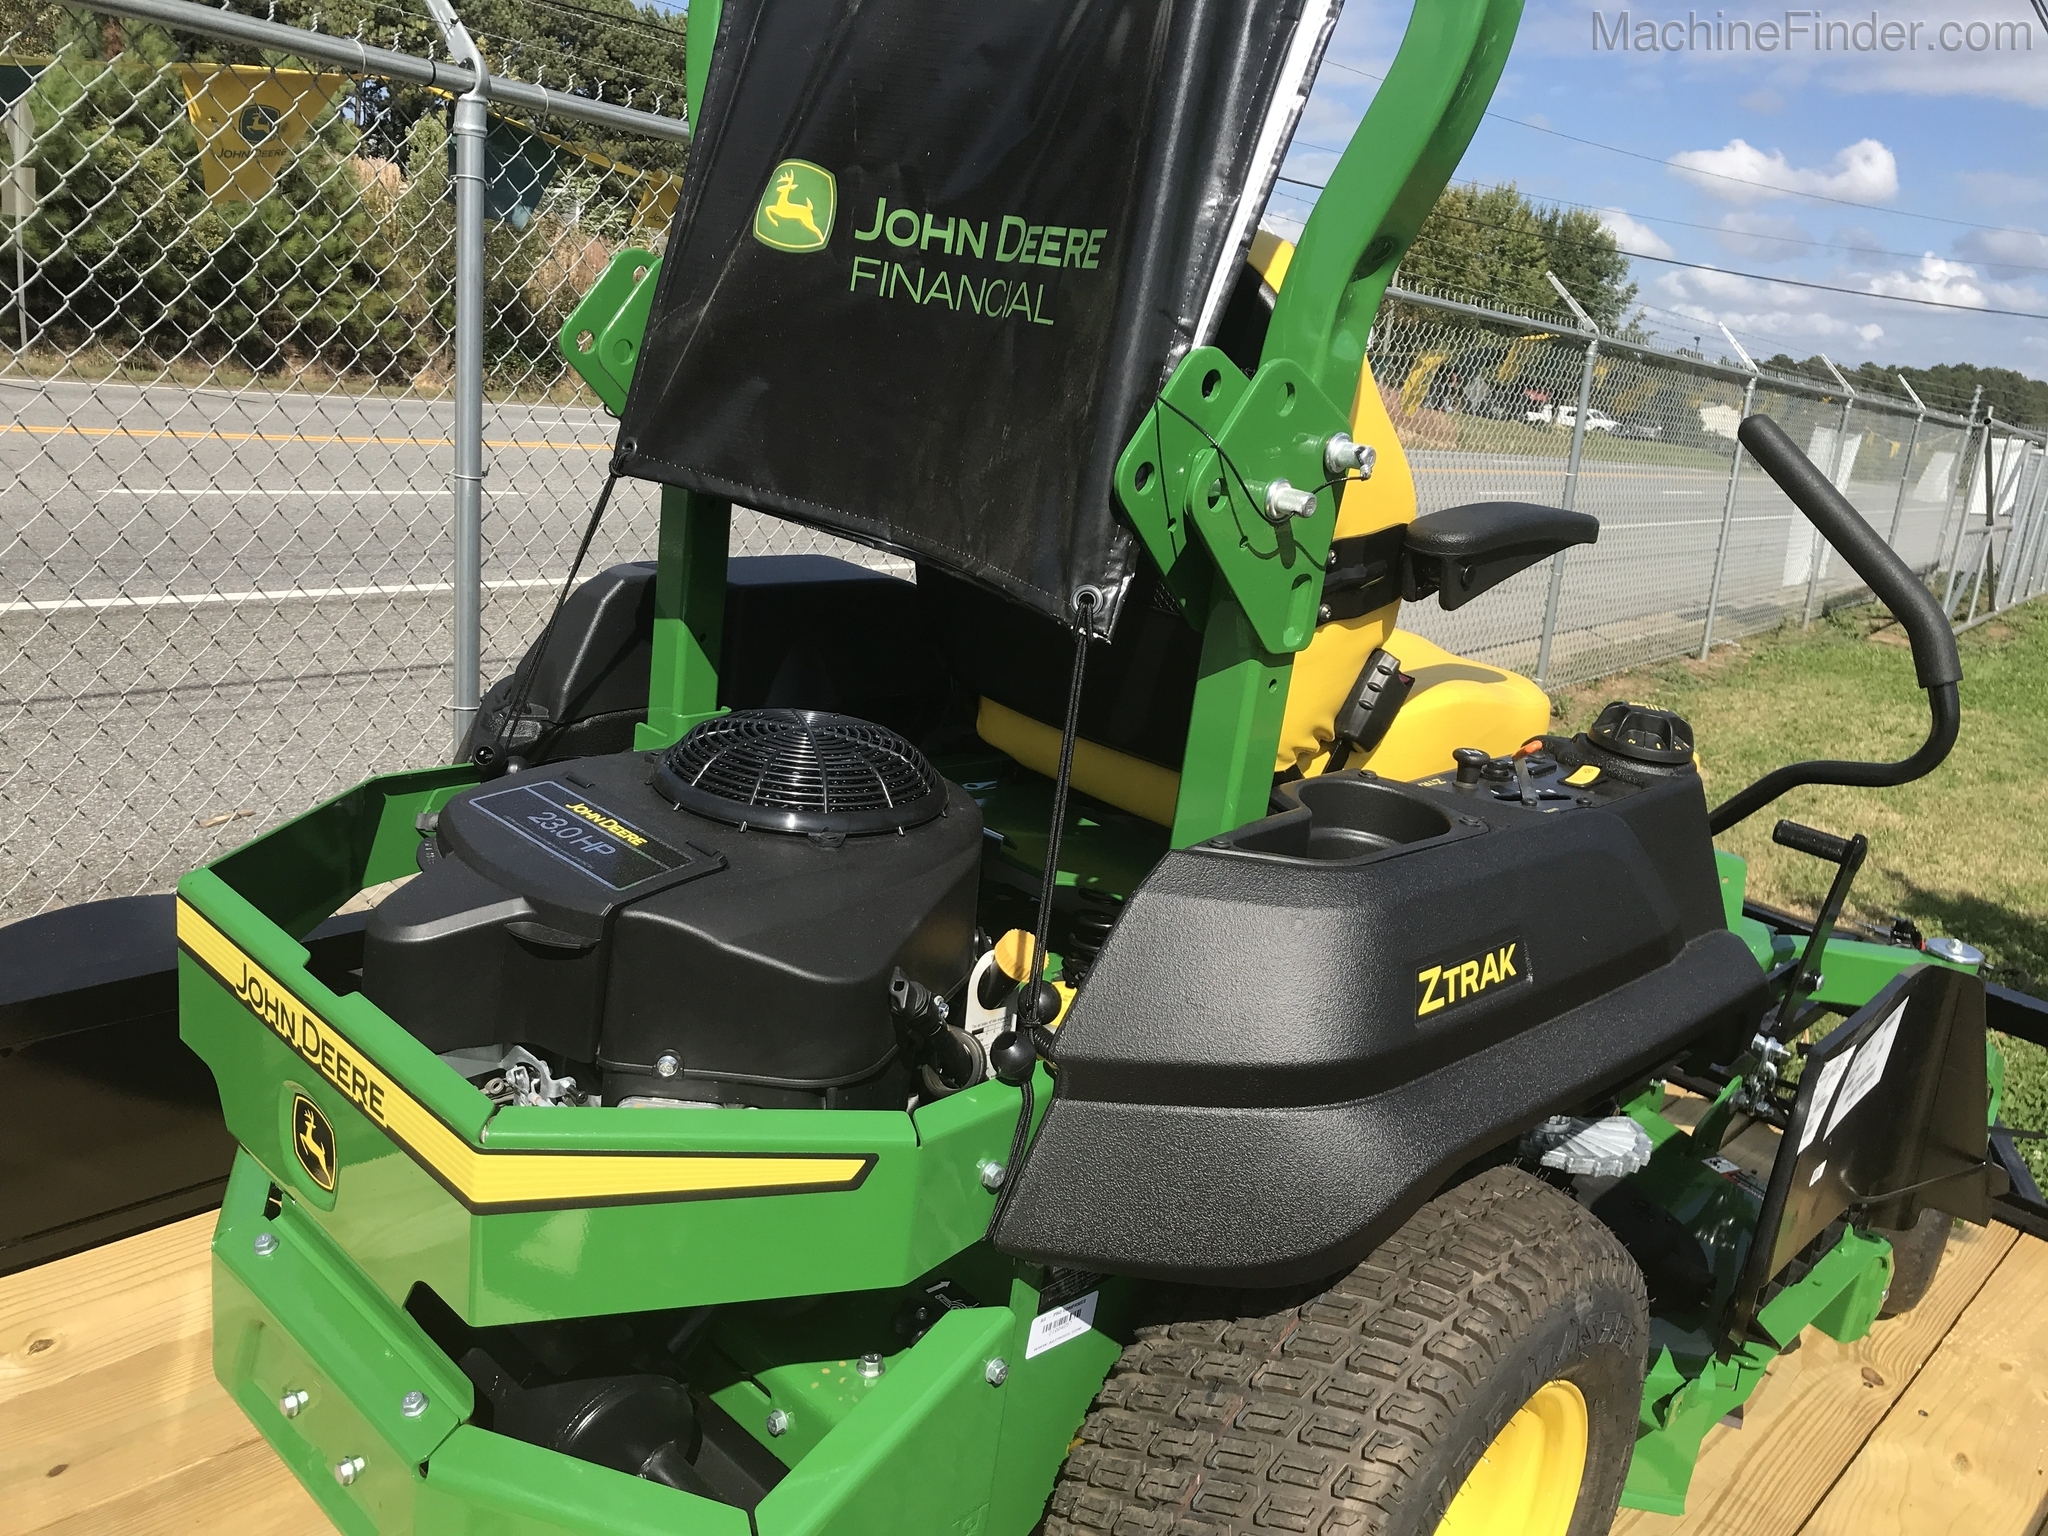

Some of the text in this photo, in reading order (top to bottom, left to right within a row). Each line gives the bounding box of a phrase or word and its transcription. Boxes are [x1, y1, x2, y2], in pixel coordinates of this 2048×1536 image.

[217, 148, 287, 159] JOHN DEERE
[854, 197, 1108, 270] JOHN DEERE
[849, 256, 1055, 326] FINANCIAL
[527, 811, 583, 839] 23.0
[569, 834, 616, 855] HP
[565, 803, 602, 823] JOHN
[599, 819, 648, 846] DEERE
[1418, 943, 1517, 1016] ZTRAK
[236, 962, 385, 1121] JOHN DEERE
